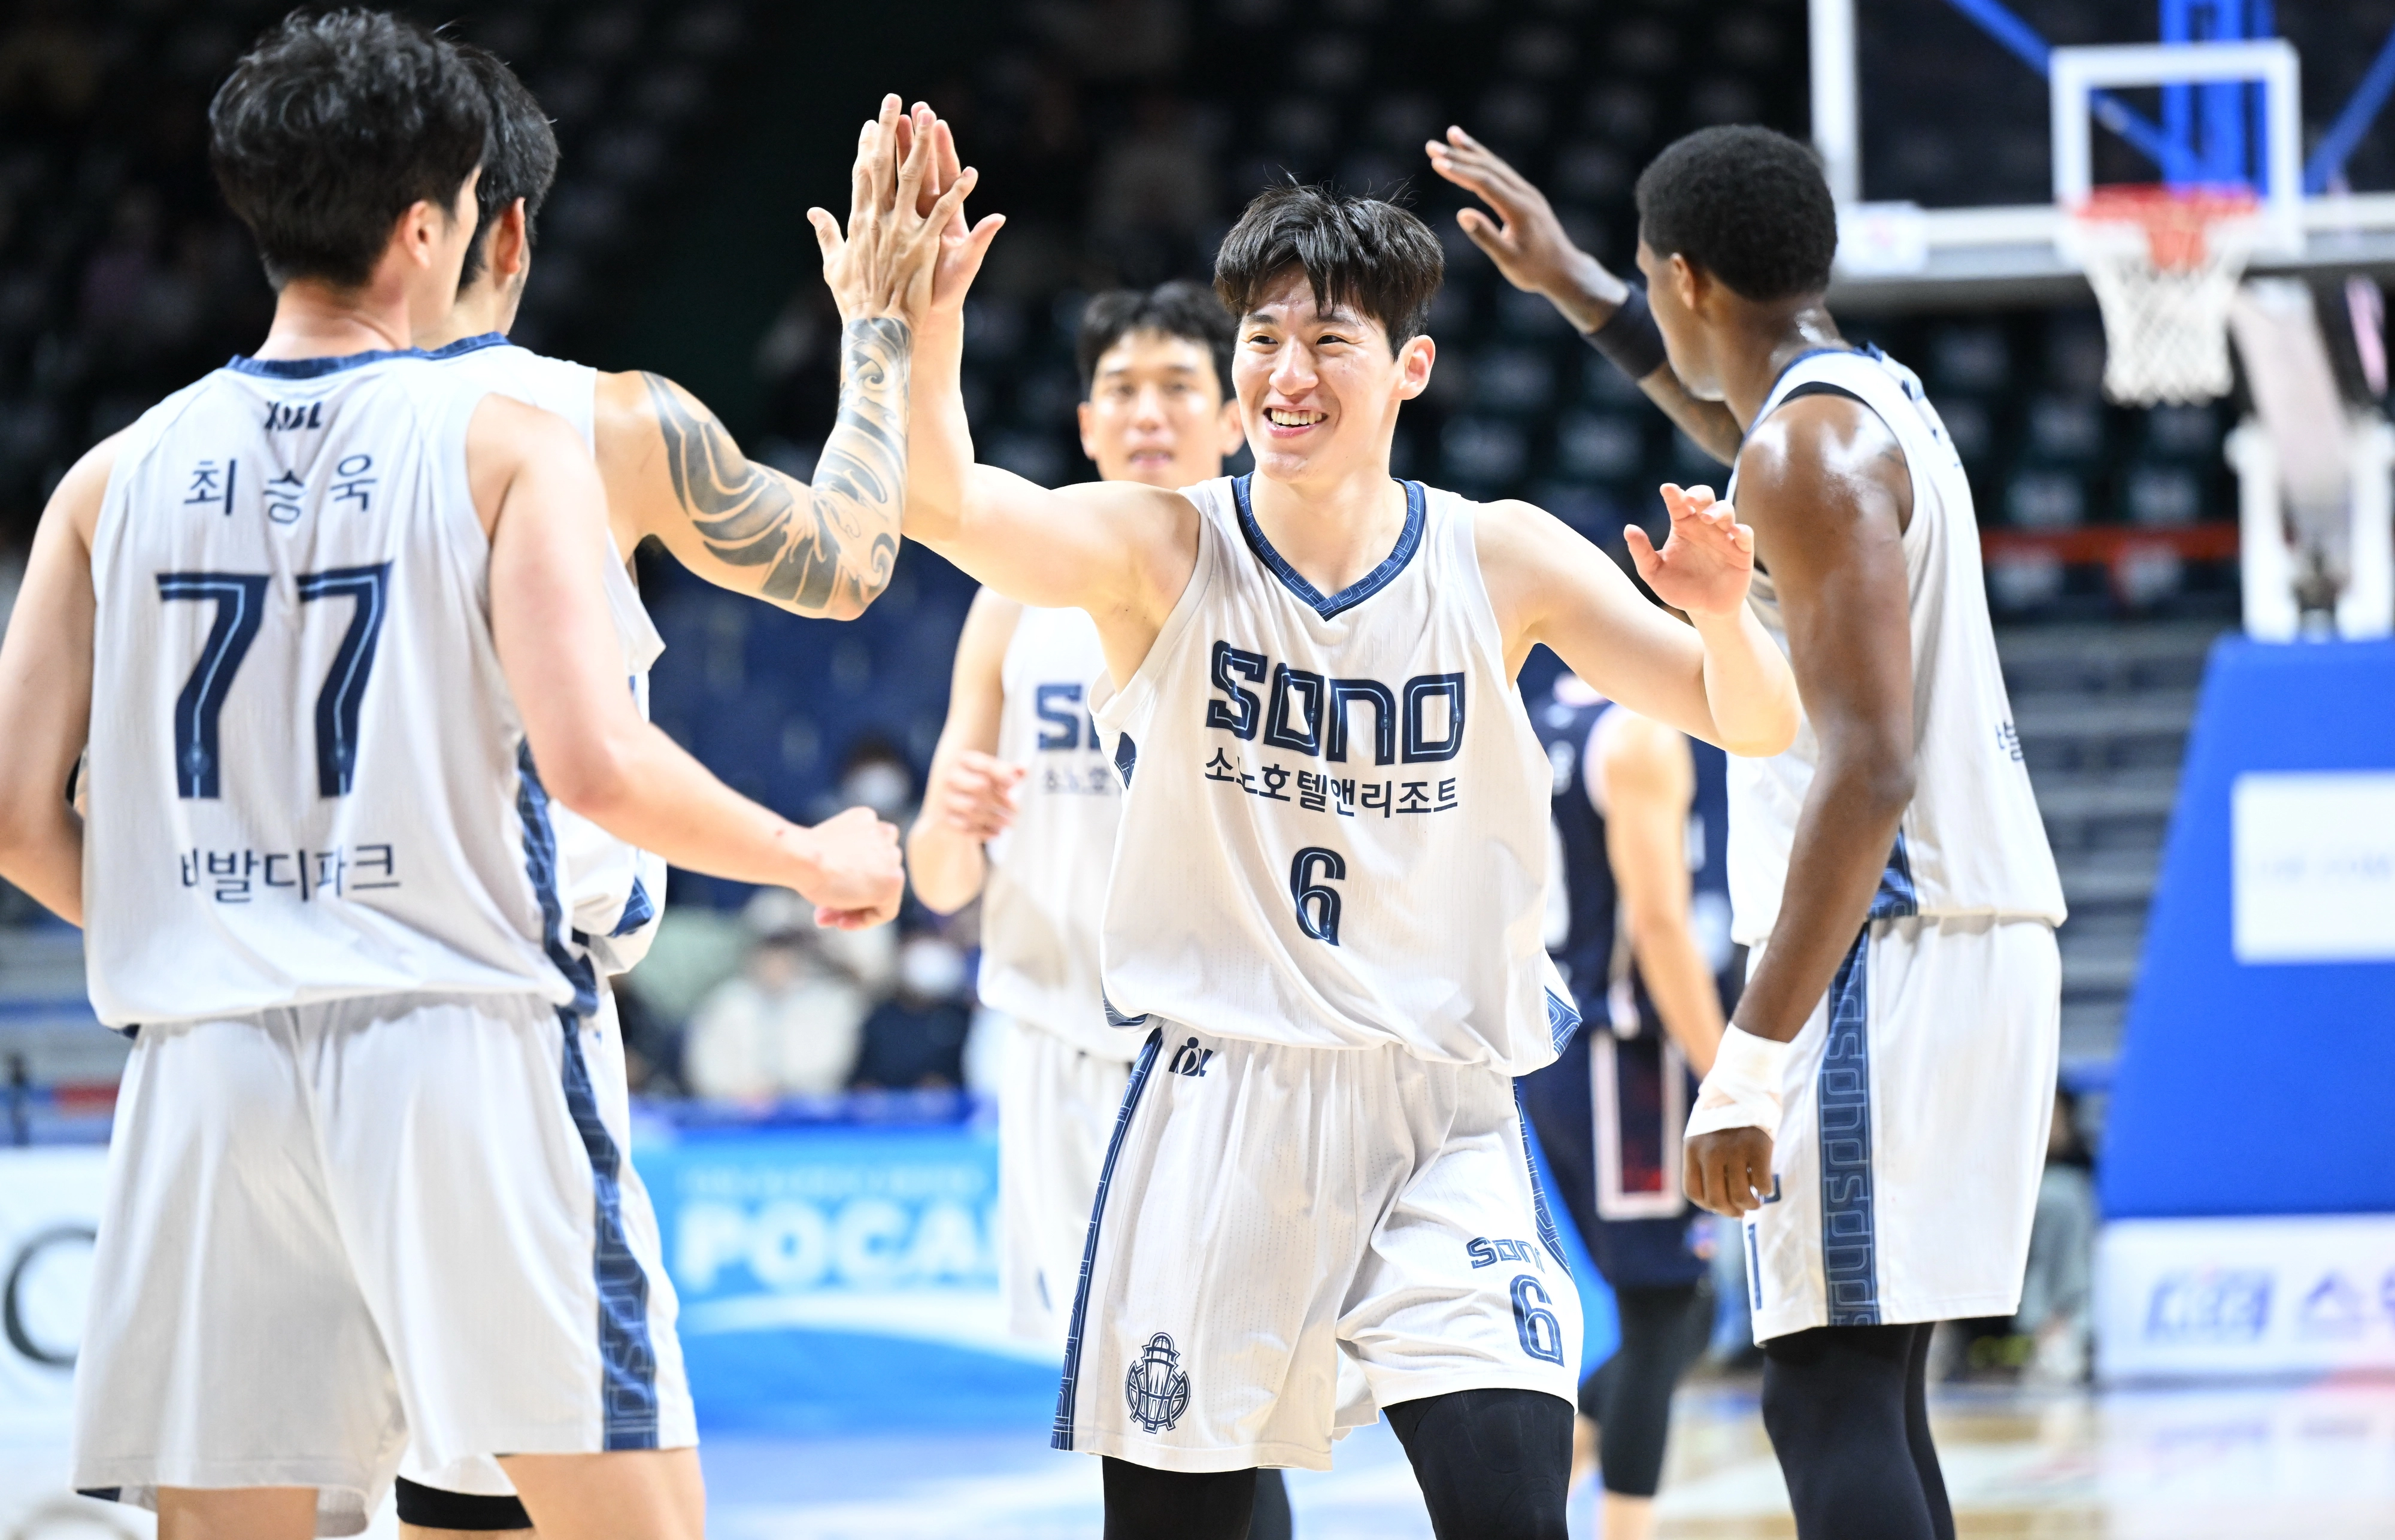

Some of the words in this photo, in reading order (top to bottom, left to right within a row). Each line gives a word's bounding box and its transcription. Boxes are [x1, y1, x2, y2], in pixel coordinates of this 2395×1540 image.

[183, 453, 378, 525] 최승욱
[156, 560, 393, 799] 77
[1204, 747, 1459, 819] 소노호텔앤리조트
[1290, 847, 1346, 947] 6
[677, 1196, 998, 1293] POCA
[1509, 1274, 1565, 1368] 6
